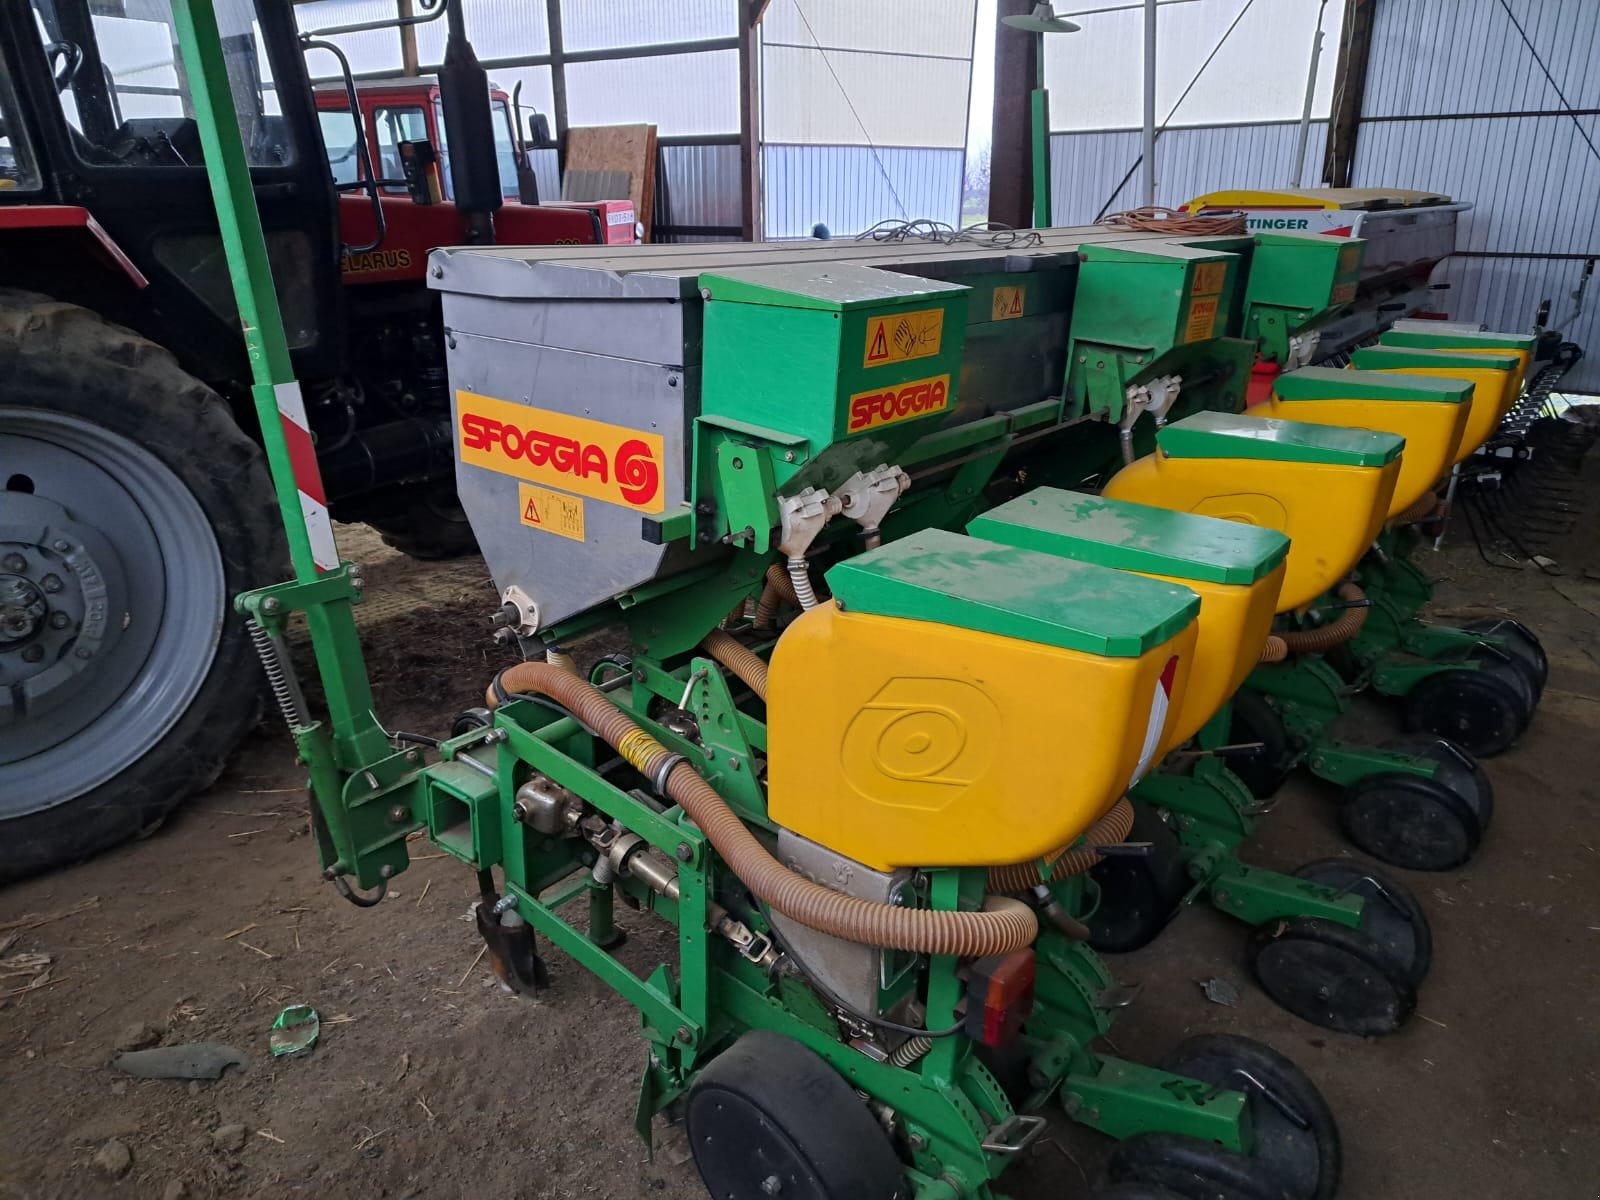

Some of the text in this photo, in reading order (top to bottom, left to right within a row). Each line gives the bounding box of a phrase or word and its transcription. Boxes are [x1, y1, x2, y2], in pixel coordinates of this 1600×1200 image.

[1248, 219, 1309, 230] TINGER
[340, 249, 411, 273] ELARUS
[851, 381, 945, 429] SFOGGIA
[461, 412, 608, 484] SFOGGIA
